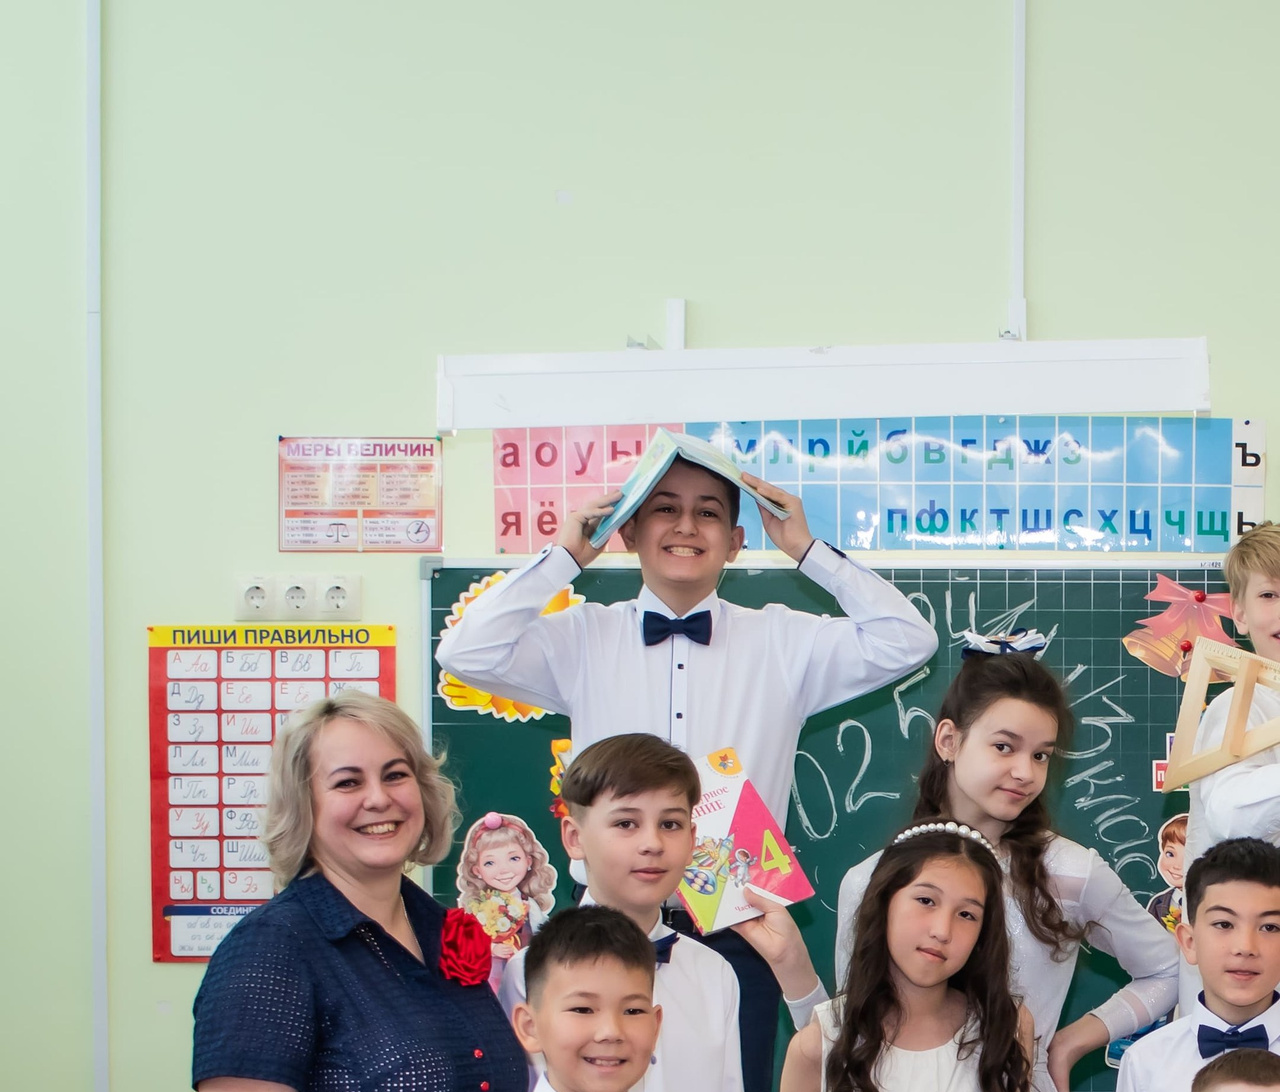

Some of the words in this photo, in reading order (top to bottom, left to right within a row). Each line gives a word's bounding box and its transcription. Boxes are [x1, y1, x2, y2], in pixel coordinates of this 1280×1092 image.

[287, 443, 341, 456] МЕРЫ
[501, 442, 520, 468] а
[535, 442, 558, 467] о
[808, 438, 830, 472] р
[886, 429, 908, 464] б
[924, 440, 946, 464] в
[961, 439, 977, 463] г
[987, 439, 1014, 470] д
[574, 442, 595, 476] у
[500, 511, 521, 536] я
[537, 501, 558, 535] ё
[887, 509, 907, 533] п
[916, 500, 949, 535] ф
[961, 509, 978, 533] к
[990, 509, 1010, 533] т
[1022, 509, 1051, 533] ш
[1098, 510, 1119, 534] х
[1130, 510, 1152, 540] ц
[1165, 511, 1185, 534] ч
[1197, 511, 1229, 542] щ
[172, 629, 237, 644] ПИШИ
[244, 629, 370, 644] ПРАВИЛЬНО
[173, 652, 182, 663] А
[226, 651, 234, 663] Б
[281, 651, 288, 663] В
[334, 651, 341, 663] Г
[172, 683, 181, 696] Д
[226, 683, 234, 694] Е
[227, 714, 235, 726] И
[173, 746, 182, 758] Л
[226, 746, 236, 758] М
[173, 778, 183, 789] П
[228, 778, 236, 789] Р
[175, 810, 183, 821] У
[226, 810, 236, 820] Ф
[174, 841, 183, 853] Ч
[227, 841, 239, 853] Ш
[761, 829, 793, 875] 4
[228, 872, 237, 884] Э
[211, 907, 256, 915] СОЕДИНЕ
